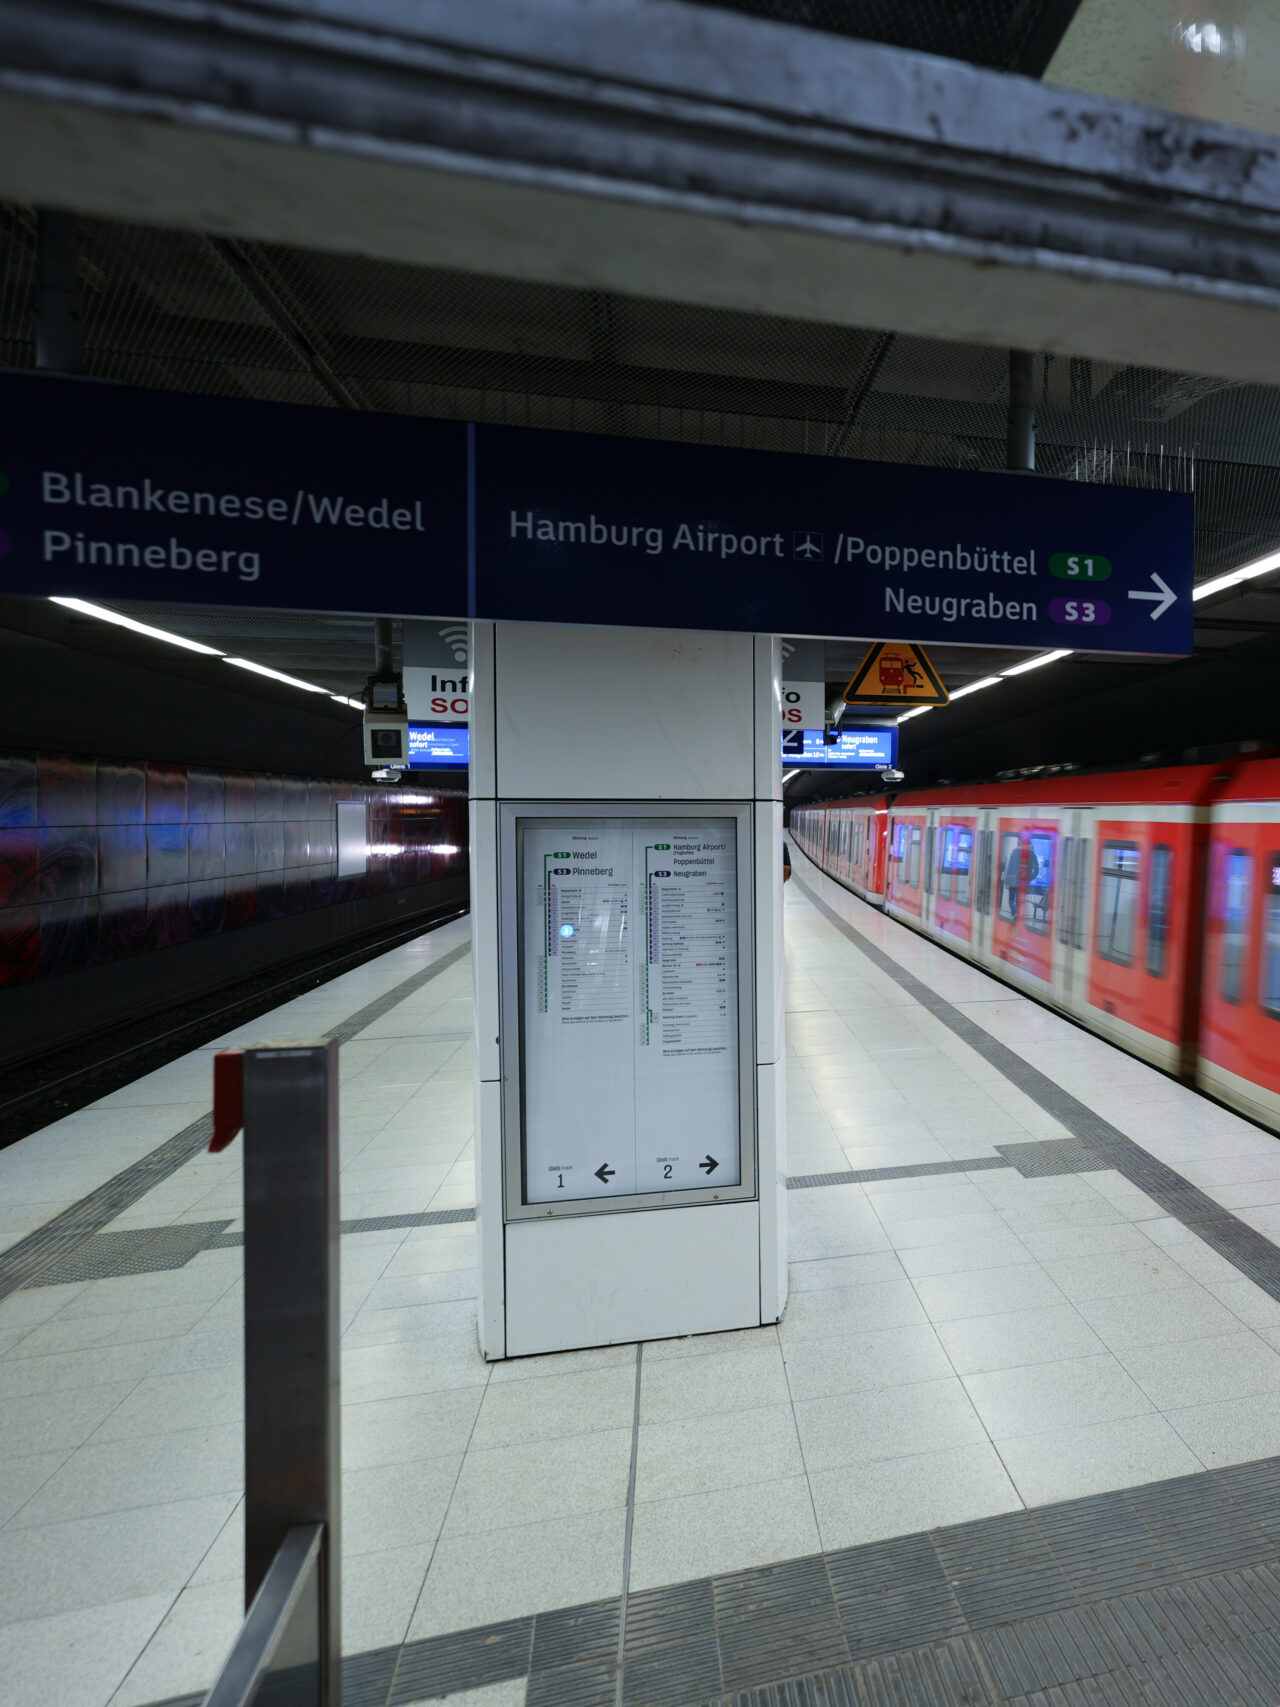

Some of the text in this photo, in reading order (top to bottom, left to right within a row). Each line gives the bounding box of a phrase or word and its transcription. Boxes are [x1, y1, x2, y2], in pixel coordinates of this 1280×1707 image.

[42, 471, 425, 531] Blankenese/Wedel
[510, 510, 1095, 577] Hamburg Airport /Poppenbüttel S1
[43, 530, 260, 581] Pinneberg
[884, 587, 1096, 622] Neugraben S3
[431, 675, 468, 693] Inf
[430, 697, 468, 714] SO
[409, 731, 435, 741] Wedel
[841, 735, 878, 745] Neugraben
[572, 851, 598, 859] Wedel
[673, 858, 715, 866] Poppenbüttel
[572, 867, 614, 877] Pinneberg
[673, 870, 707, 878] Neugraben
[664, 1164, 673, 1179] 2
[557, 1174, 565, 1188] 1
